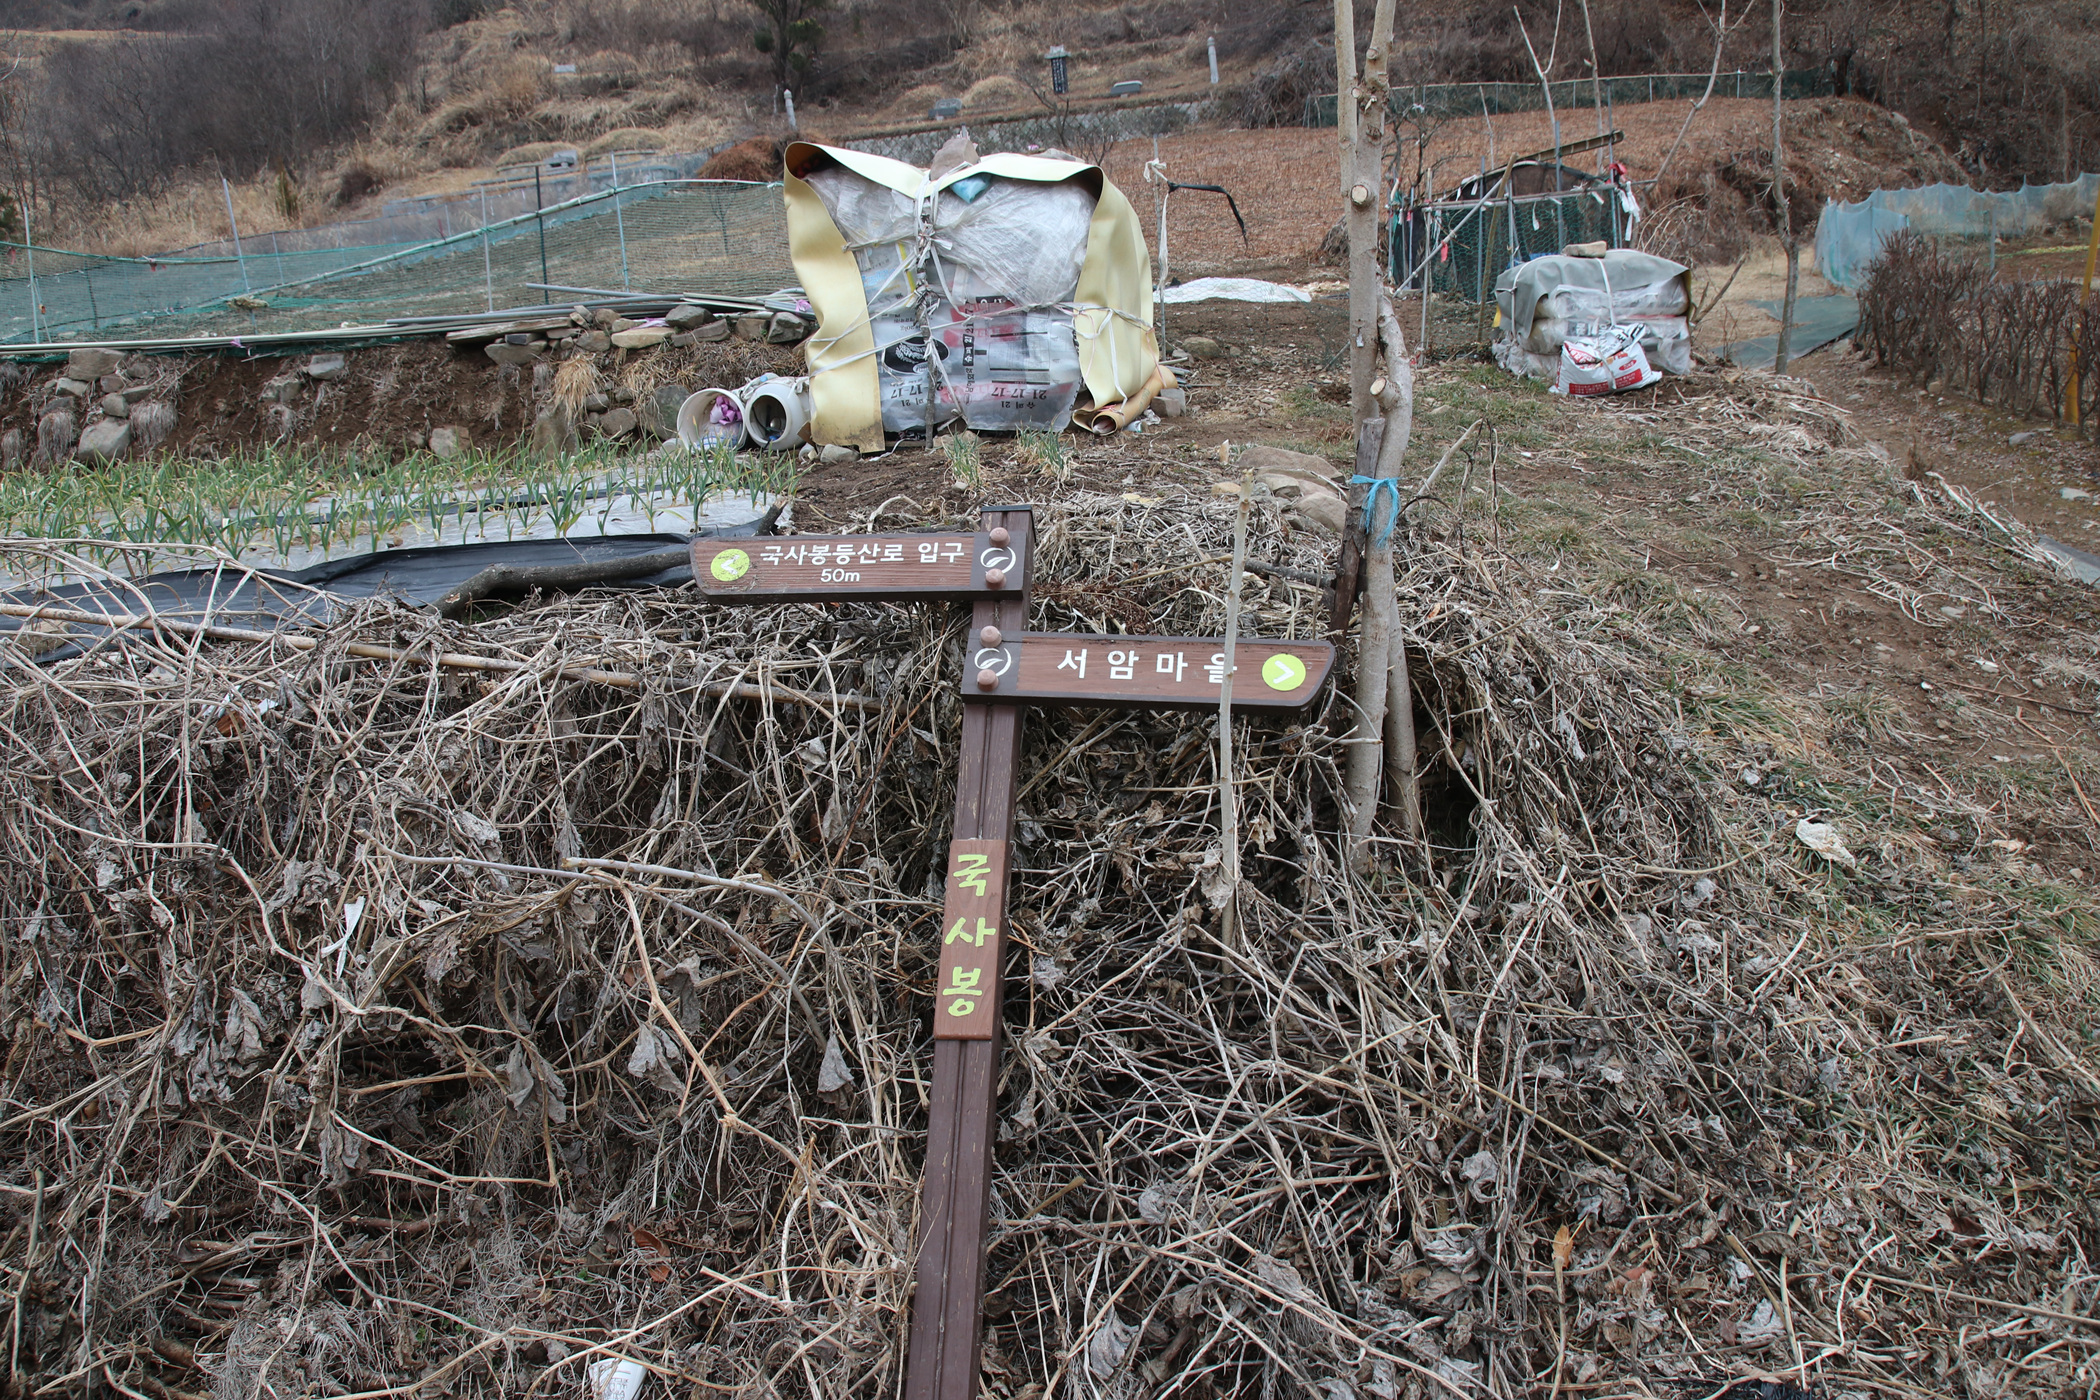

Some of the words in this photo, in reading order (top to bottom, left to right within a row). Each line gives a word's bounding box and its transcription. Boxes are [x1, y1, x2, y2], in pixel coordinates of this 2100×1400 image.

[991, 387, 1048, 400] 21-17-17
[760, 543, 905, 565] 국사봉등산로
[917, 542, 965, 563] 입구
[820, 568, 861, 583] 50m
[942, 854, 997, 1017] 국사봉
